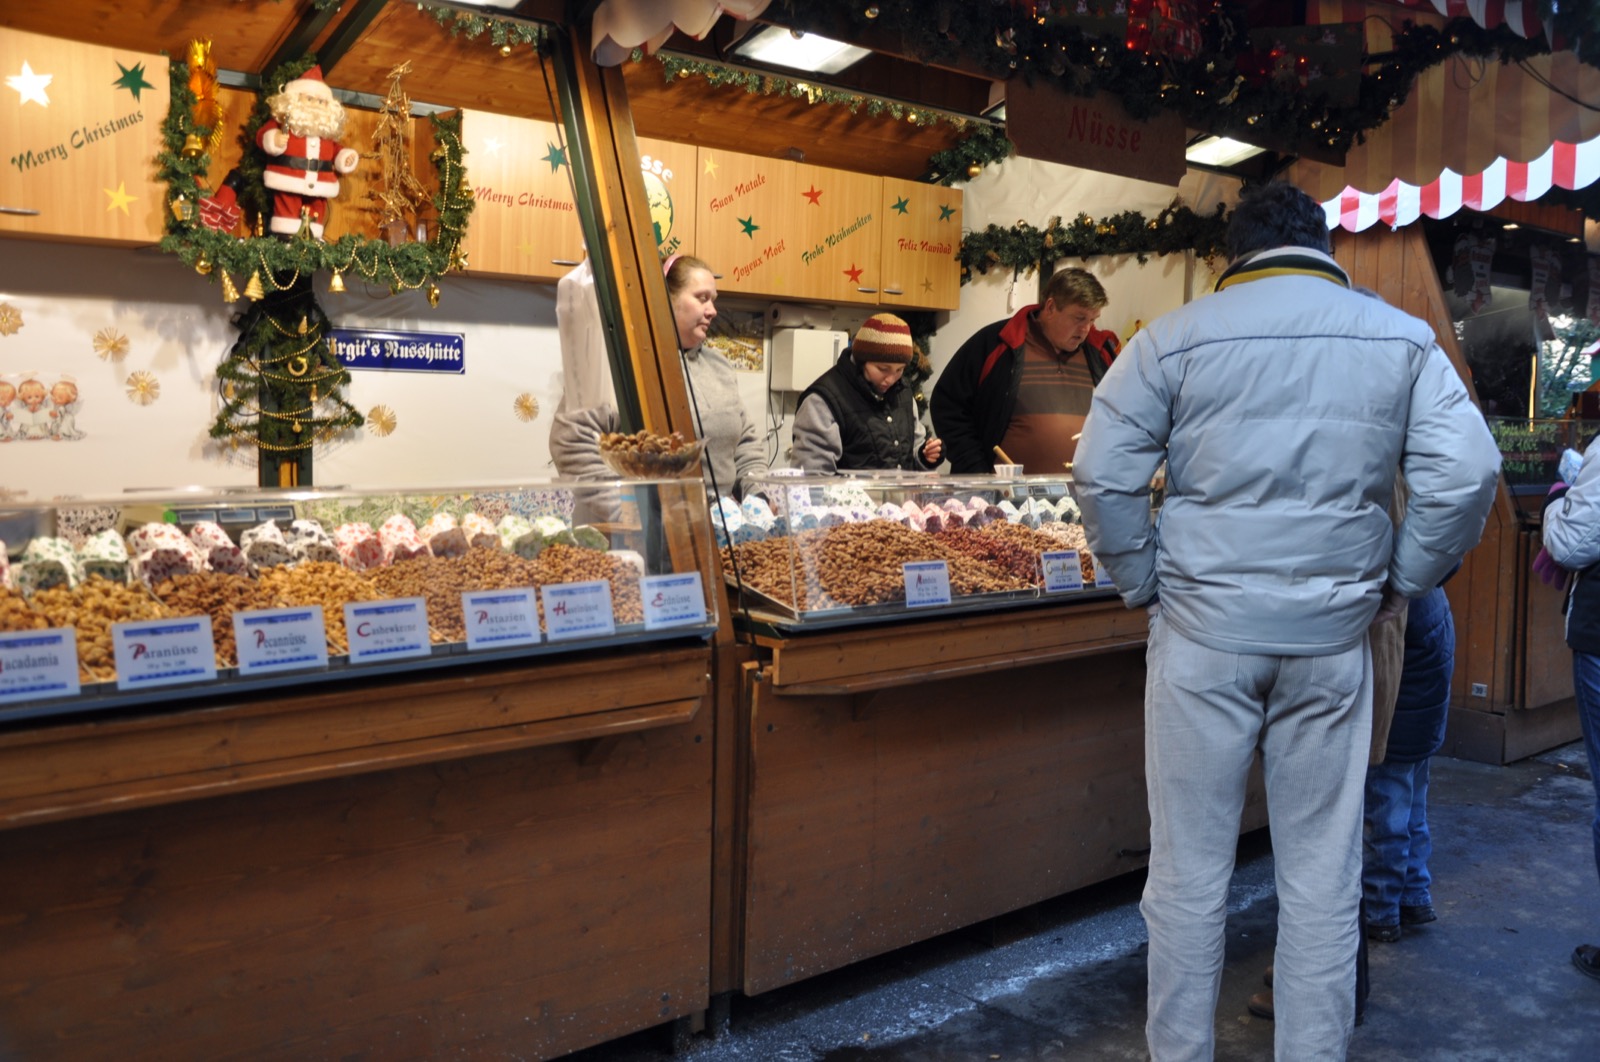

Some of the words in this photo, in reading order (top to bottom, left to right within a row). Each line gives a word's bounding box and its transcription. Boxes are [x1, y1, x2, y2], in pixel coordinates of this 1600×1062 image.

[11, 143, 68, 173] Merry
[70, 110, 144, 149] Christmas
[1067, 106, 1142, 152] Nüsse
[475, 186, 514, 207] Merry
[518, 192, 573, 212] Christmas
[709, 194, 734, 214] Buon
[734, 173, 767, 197] Natale
[824, 213, 873, 249] Weihnachten
[897, 238, 918, 253] Feliz
[920, 240, 952, 255] Navidad
[733, 257, 763, 282] Joyeux
[763, 239, 786, 260] Noël
[356, 622, 417, 638] Cashewkerne
[474, 609, 526, 625] Pistazien
[128, 642, 199, 660] Paranüsse
[253, 628, 307, 649] Pecannüsse
